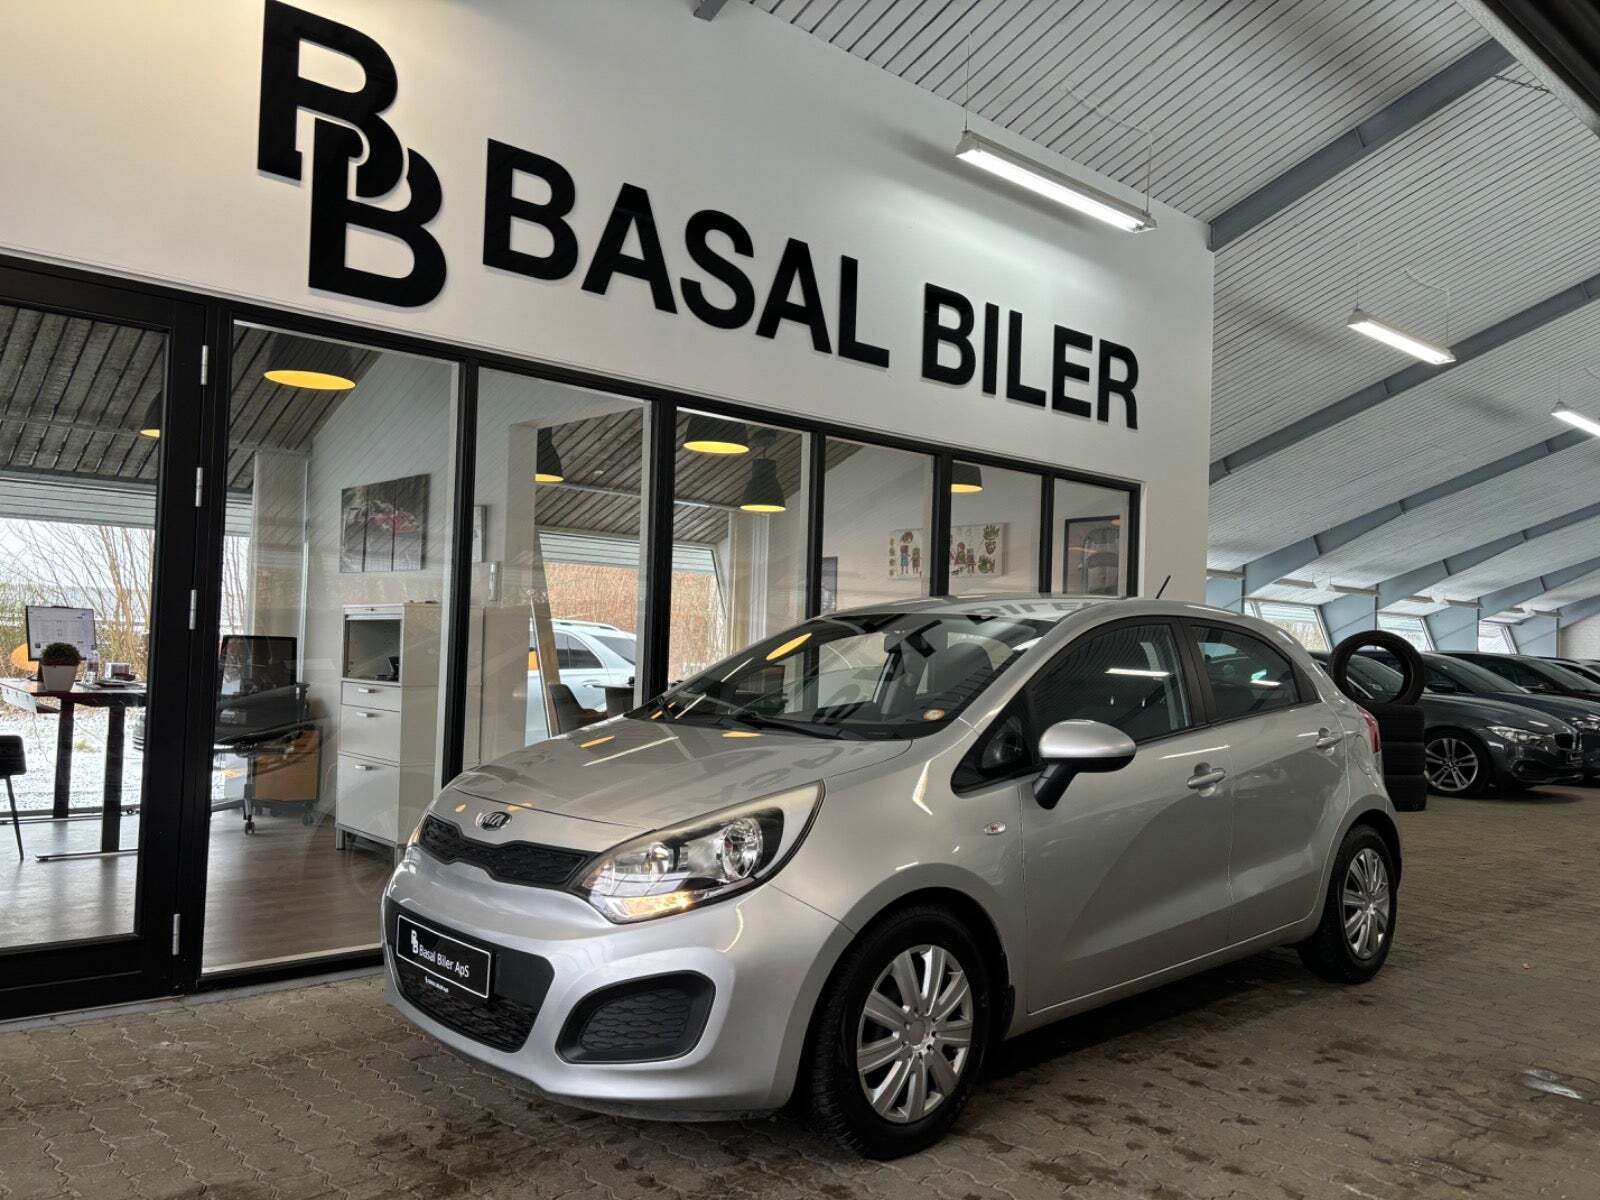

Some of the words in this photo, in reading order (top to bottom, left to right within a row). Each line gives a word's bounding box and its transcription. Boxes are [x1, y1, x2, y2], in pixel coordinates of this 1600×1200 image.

[483, 138, 889, 369] BASAL
[922, 282, 1139, 430] BILER
[419, 944, 436, 963] Basal
[437, 953, 454, 970] Biler
[455, 961, 470, 978] ApS
